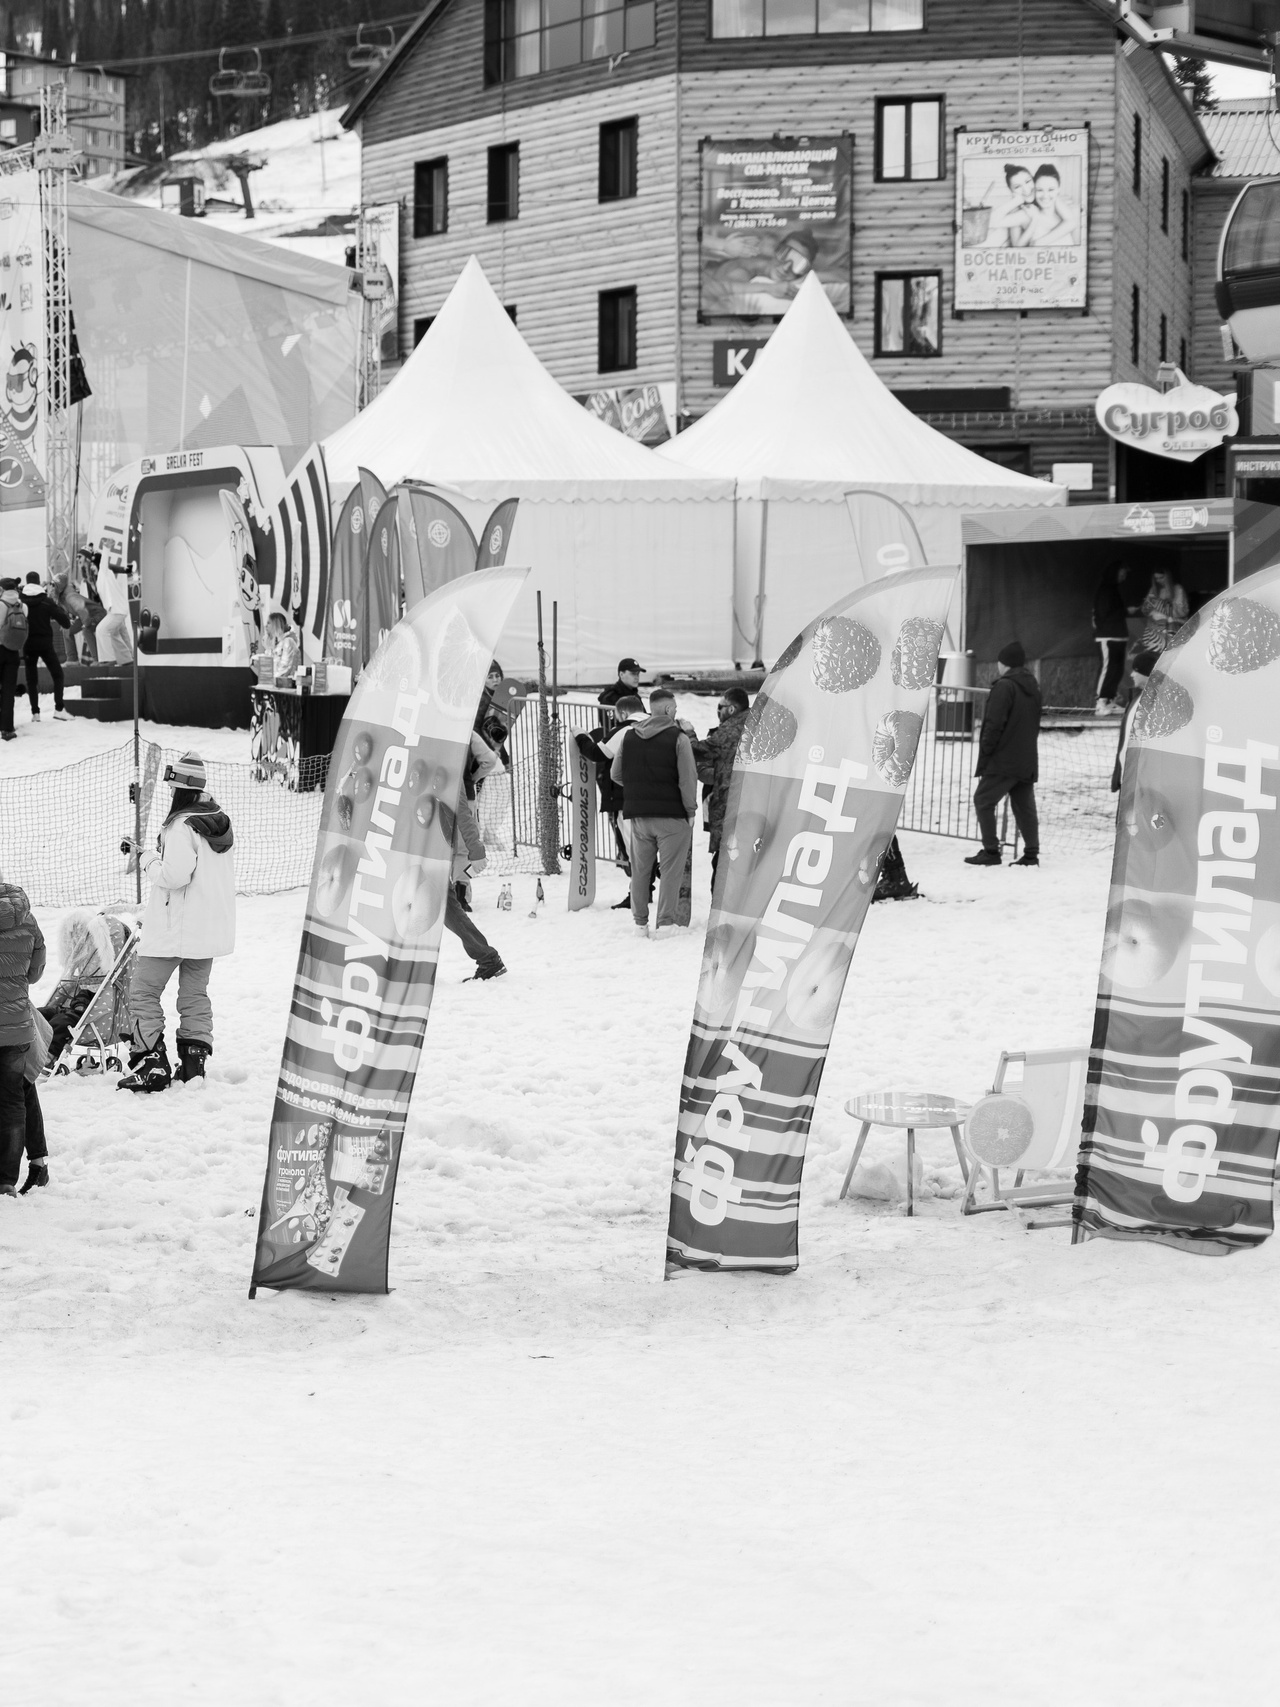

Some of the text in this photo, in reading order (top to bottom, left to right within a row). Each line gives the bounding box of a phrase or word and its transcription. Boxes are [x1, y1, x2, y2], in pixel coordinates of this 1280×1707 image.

[966, 133, 1078, 145] КРУГЛОСУТОЧНО
[716, 147, 838, 165] ВОССТАНАВЛИВАЮЩИЙ
[743, 162, 810, 176] СПА-МАССАЖ
[963, 250, 1079, 266] ВОСЕМЬ БАНЬ
[988, 267, 1054, 281] НА ГОРЕ
[1104, 402, 1230, 438] Сугроб
[166, 454, 187, 470] GRELKA
[189, 452, 204, 467] FEST
[579, 788, 589, 897] SNOWBOARDS
[321, 688, 430, 1072] фрутилад
[1141, 738, 1280, 1203] фрутилад
[677, 757, 869, 1226] фрутилад
[302, 1097, 335, 1114] всей
[276, 1144, 323, 1164] фрутила
[278, 1167, 306, 1177] гранола
